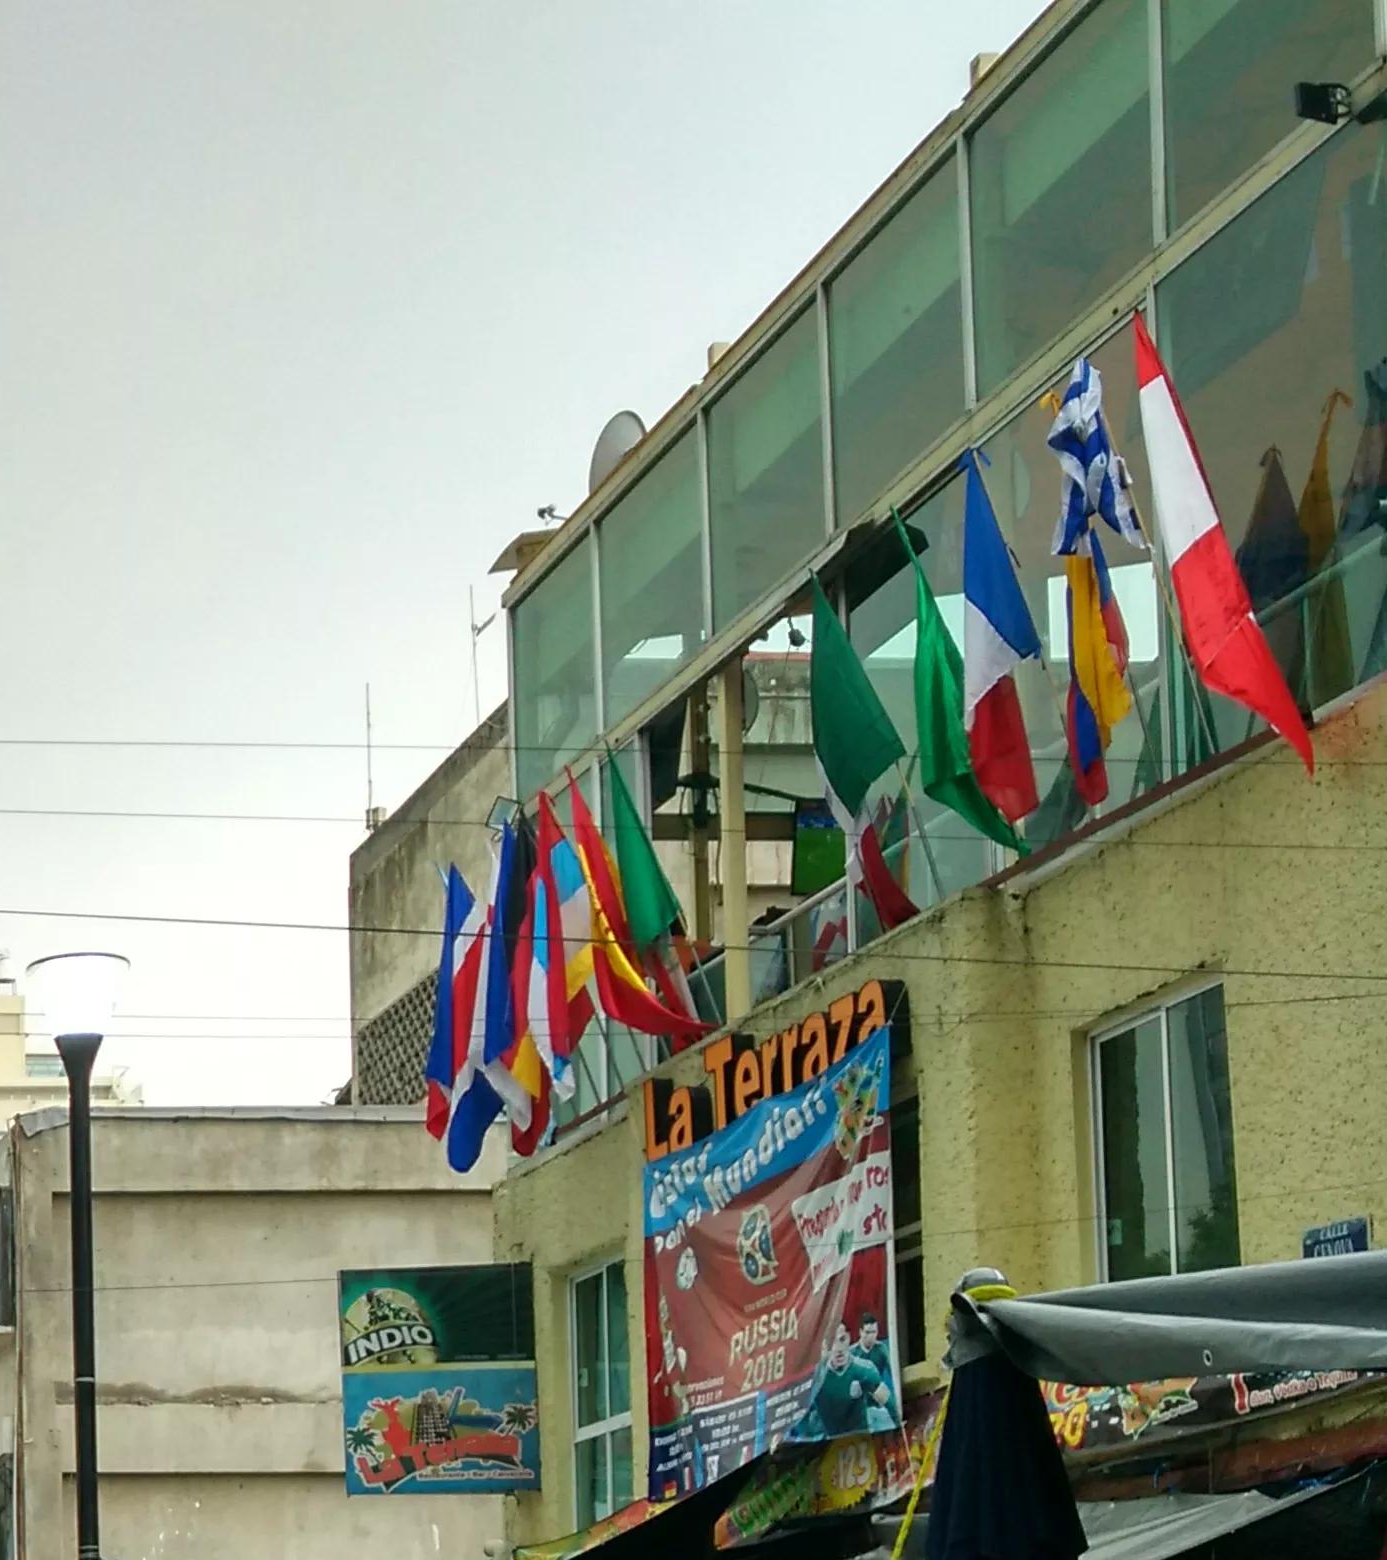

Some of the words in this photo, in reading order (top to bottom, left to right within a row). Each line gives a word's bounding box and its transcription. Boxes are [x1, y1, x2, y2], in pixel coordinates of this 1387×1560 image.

[644, 1078, 693, 1162] La
[703, 980, 887, 1131] Terraza
[1320, 1222, 1348, 1241] CALLE
[347, 1325, 434, 1364] INDIO
[729, 1307, 799, 1367] RUSSIA
[741, 1346, 786, 1393] 2018
